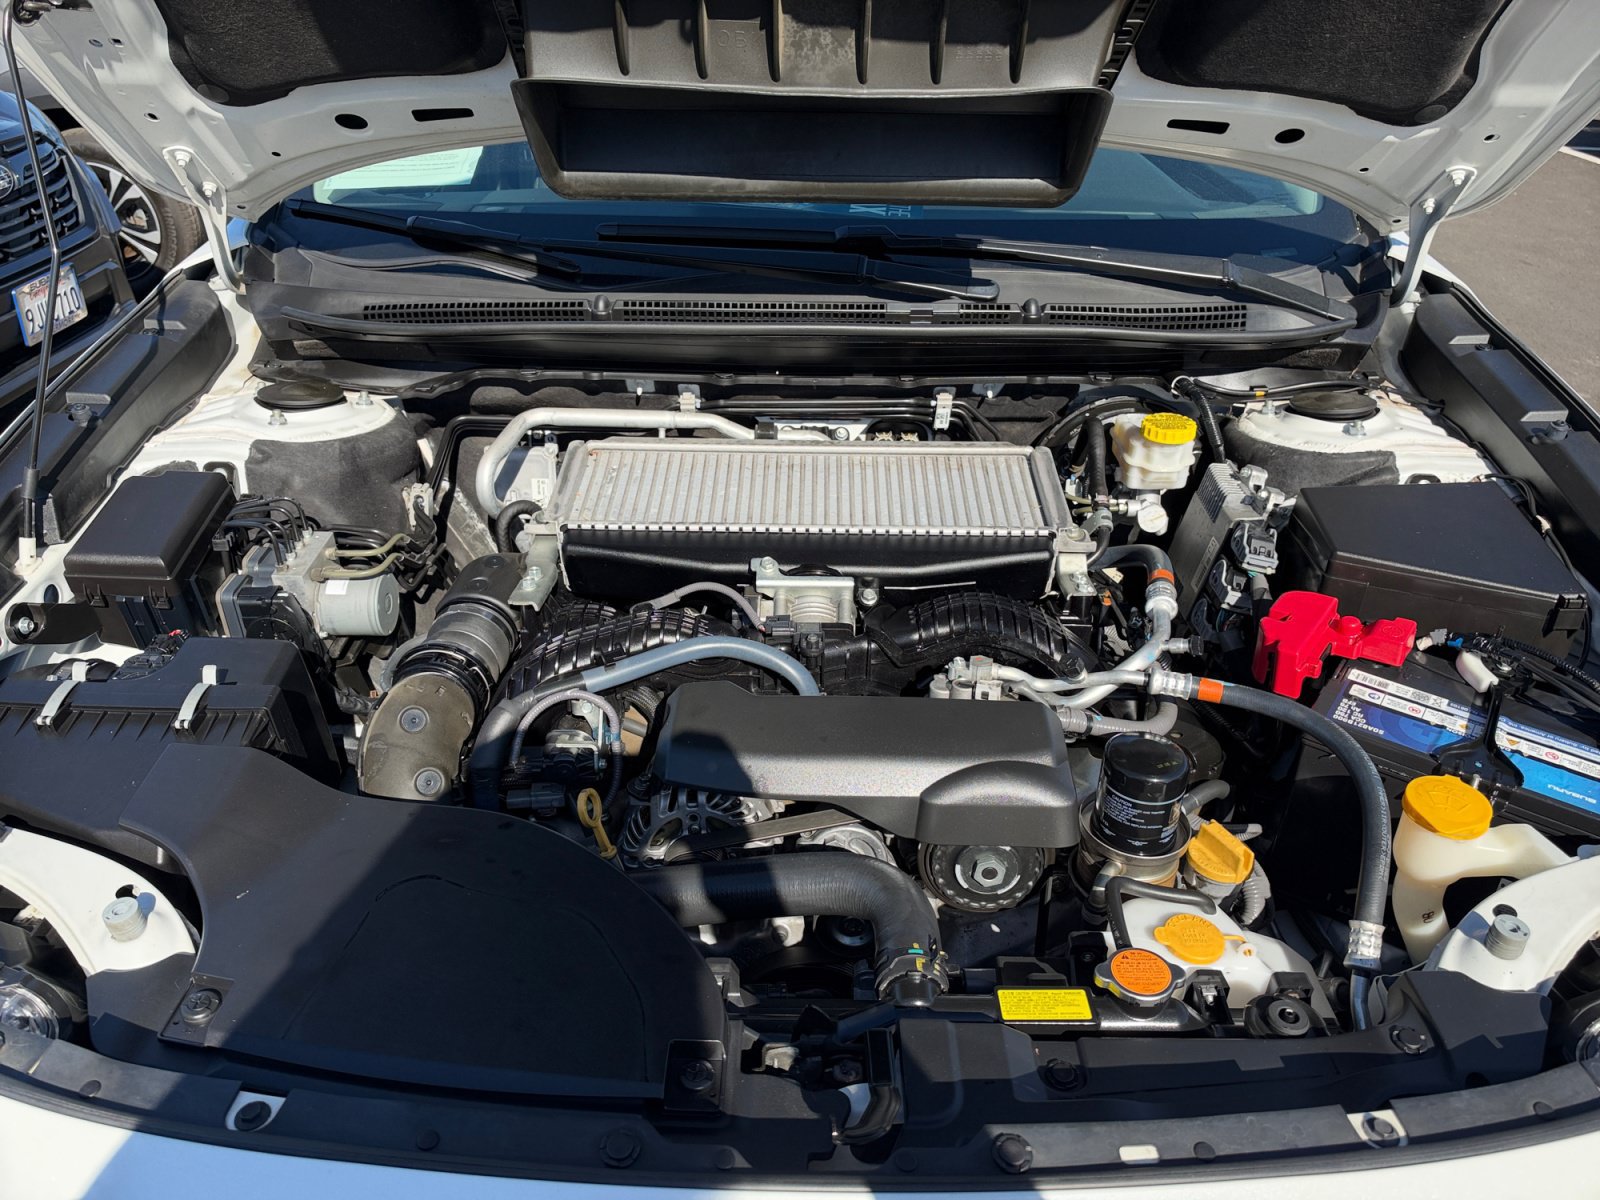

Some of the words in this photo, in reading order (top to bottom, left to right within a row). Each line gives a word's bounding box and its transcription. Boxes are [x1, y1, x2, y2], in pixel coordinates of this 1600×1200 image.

[25, 286, 81, 334] 9J710
[1111, 794, 1133, 808] CAUTION
[1547, 783, 1597, 804] SUBARU
